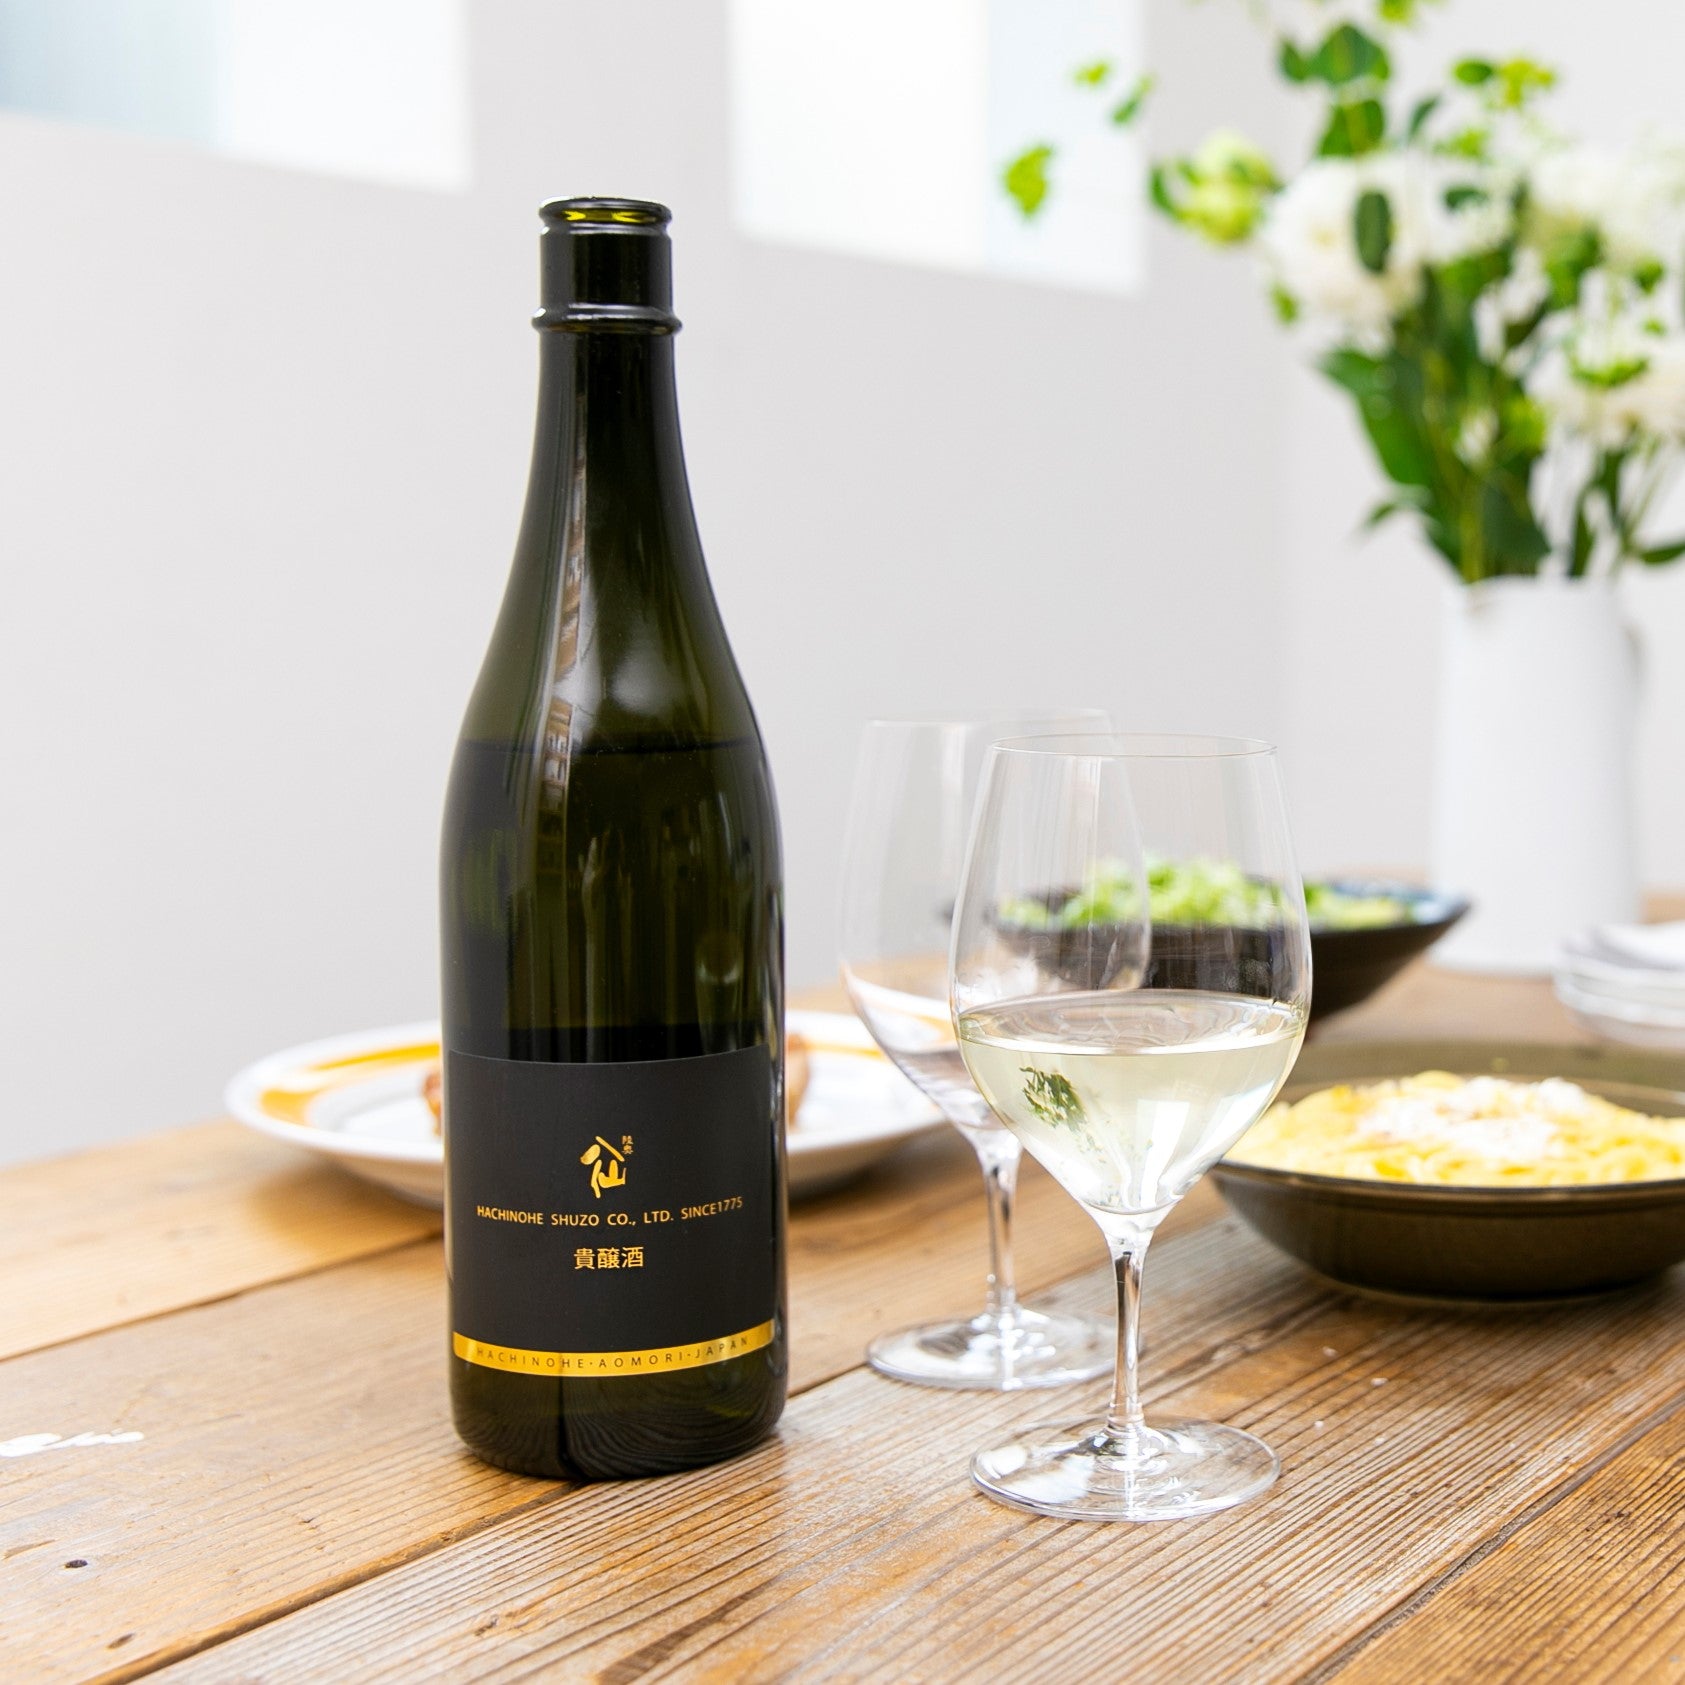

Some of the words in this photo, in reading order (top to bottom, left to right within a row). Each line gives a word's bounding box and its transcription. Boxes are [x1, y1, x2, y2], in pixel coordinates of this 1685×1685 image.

[476, 1204, 544, 1225] HACHINOHE
[550, 1213, 600, 1227] SHUZO
[606, 1213, 637, 1226] CO.,
[643, 1210, 674, 1224] LTD.
[573, 1246, 644, 1270] 貴醸酒
